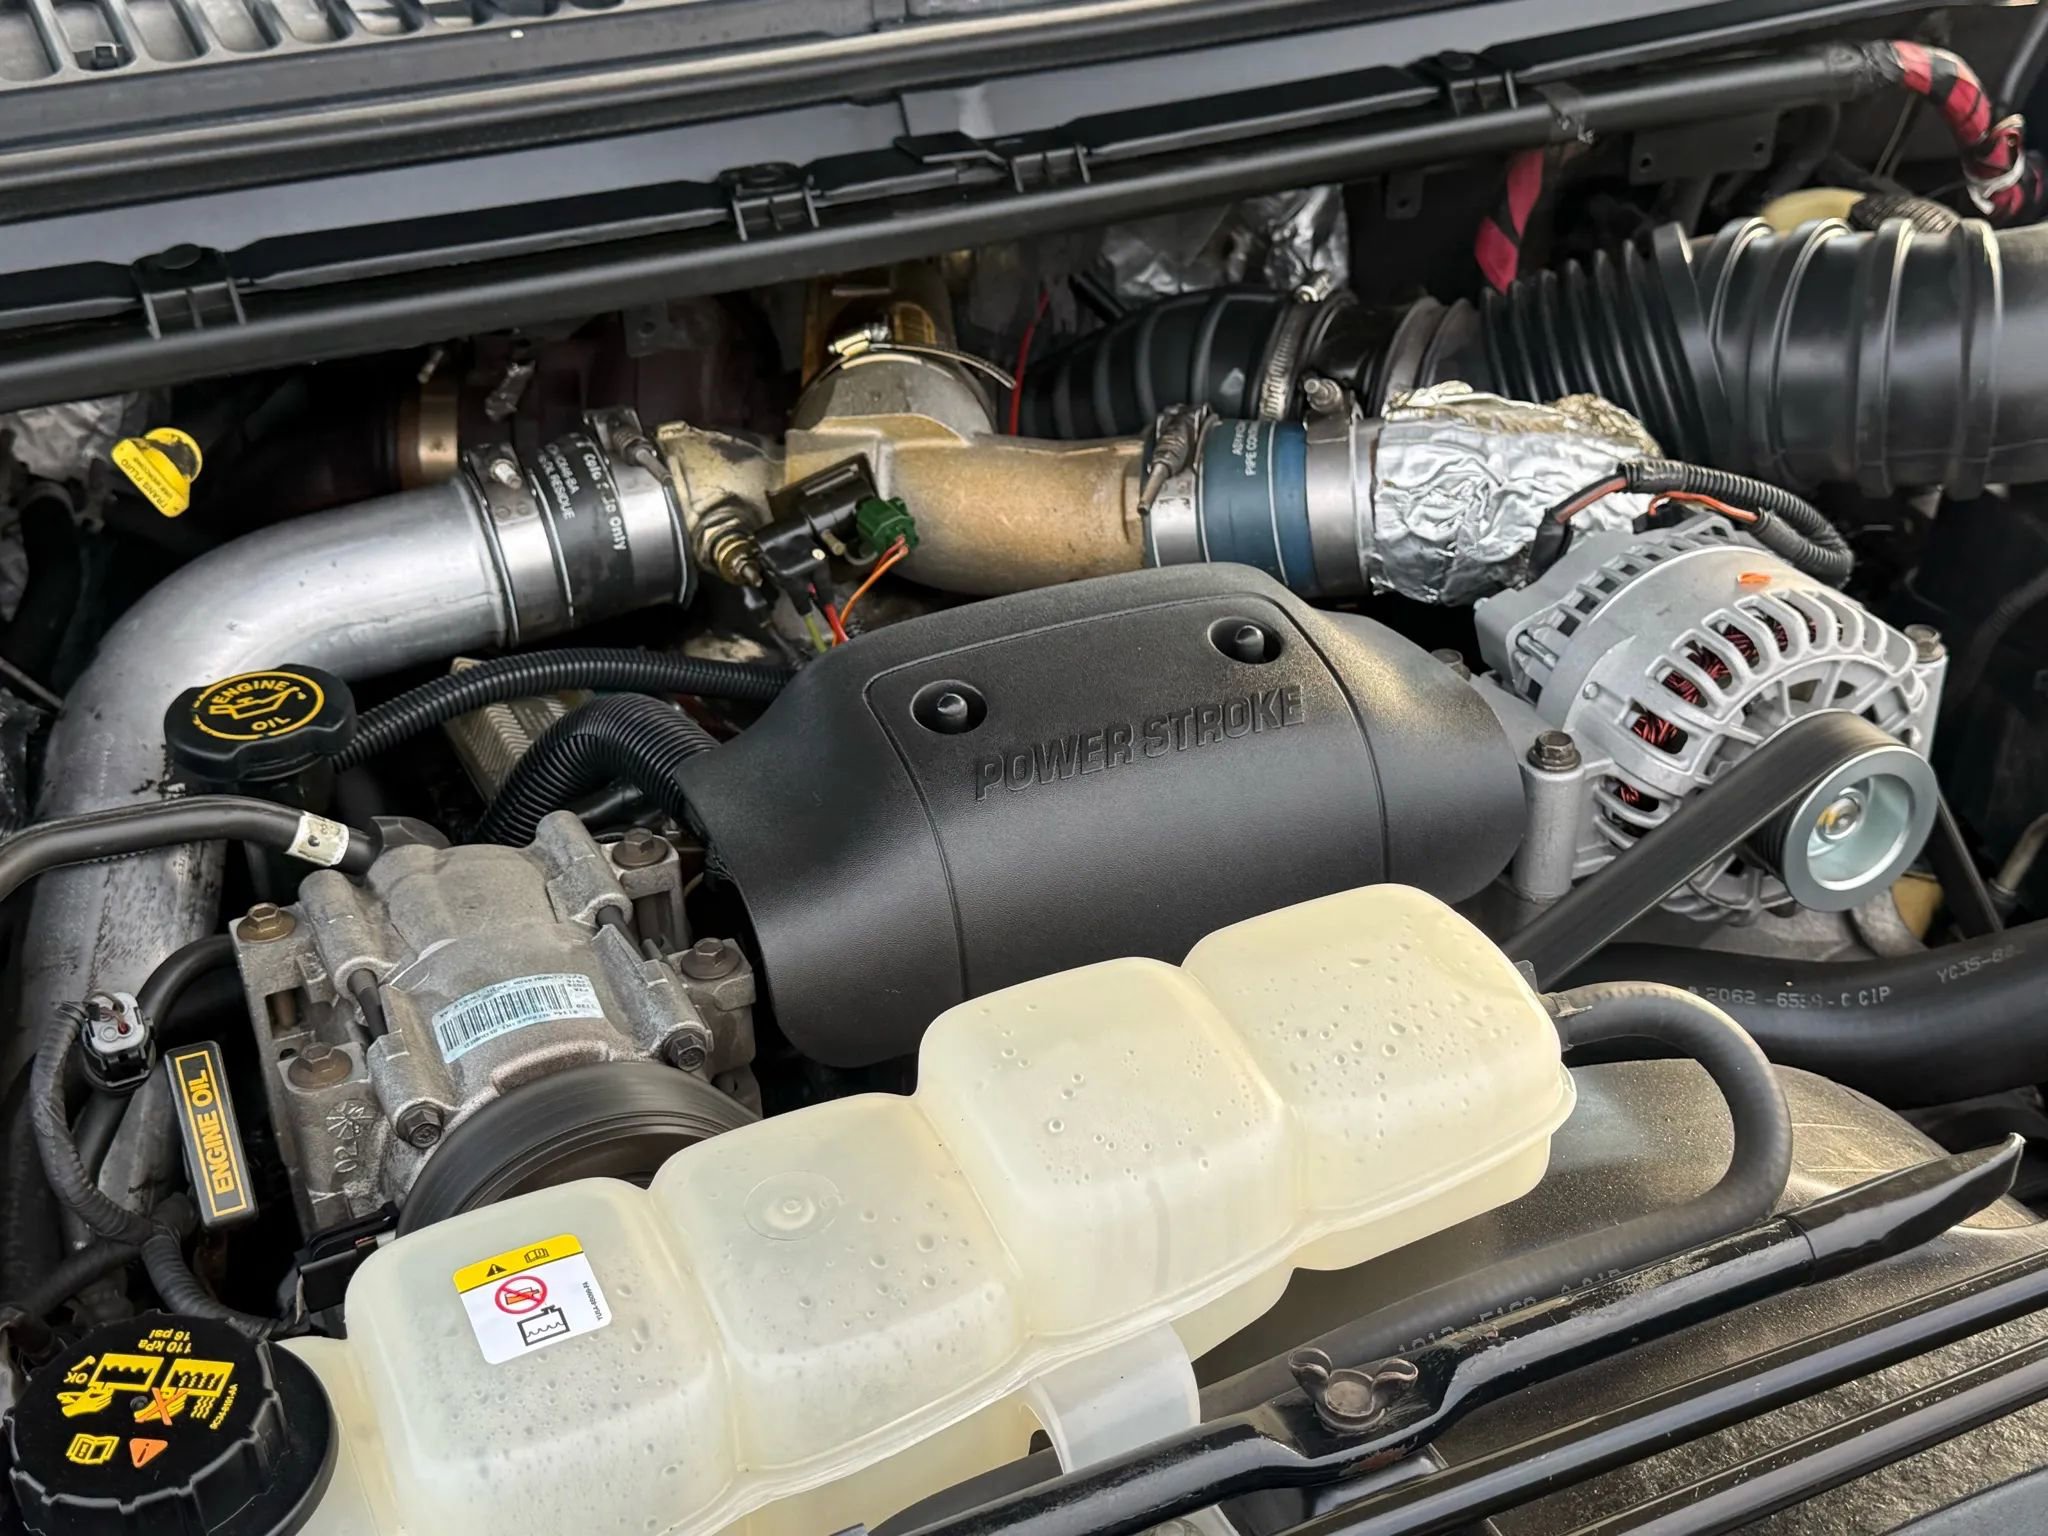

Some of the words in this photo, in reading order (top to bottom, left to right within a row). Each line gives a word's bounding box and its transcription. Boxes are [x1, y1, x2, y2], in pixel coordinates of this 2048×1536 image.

[609, 516, 627, 550] Only
[211, 680, 290, 704] ENGINE
[251, 716, 291, 731] OIL
[976, 723, 1133, 800] POWER
[1144, 685, 1304, 758] STROKE
[188, 1069, 213, 1107] OIL
[197, 1110, 235, 1194] ENGINE
[149, 1328, 173, 1339] psi
[176, 1331, 191, 1341] 16
[137, 1339, 163, 1352] kPa
[166, 1342, 192, 1354] 110
[63, 1371, 88, 1384] OK
